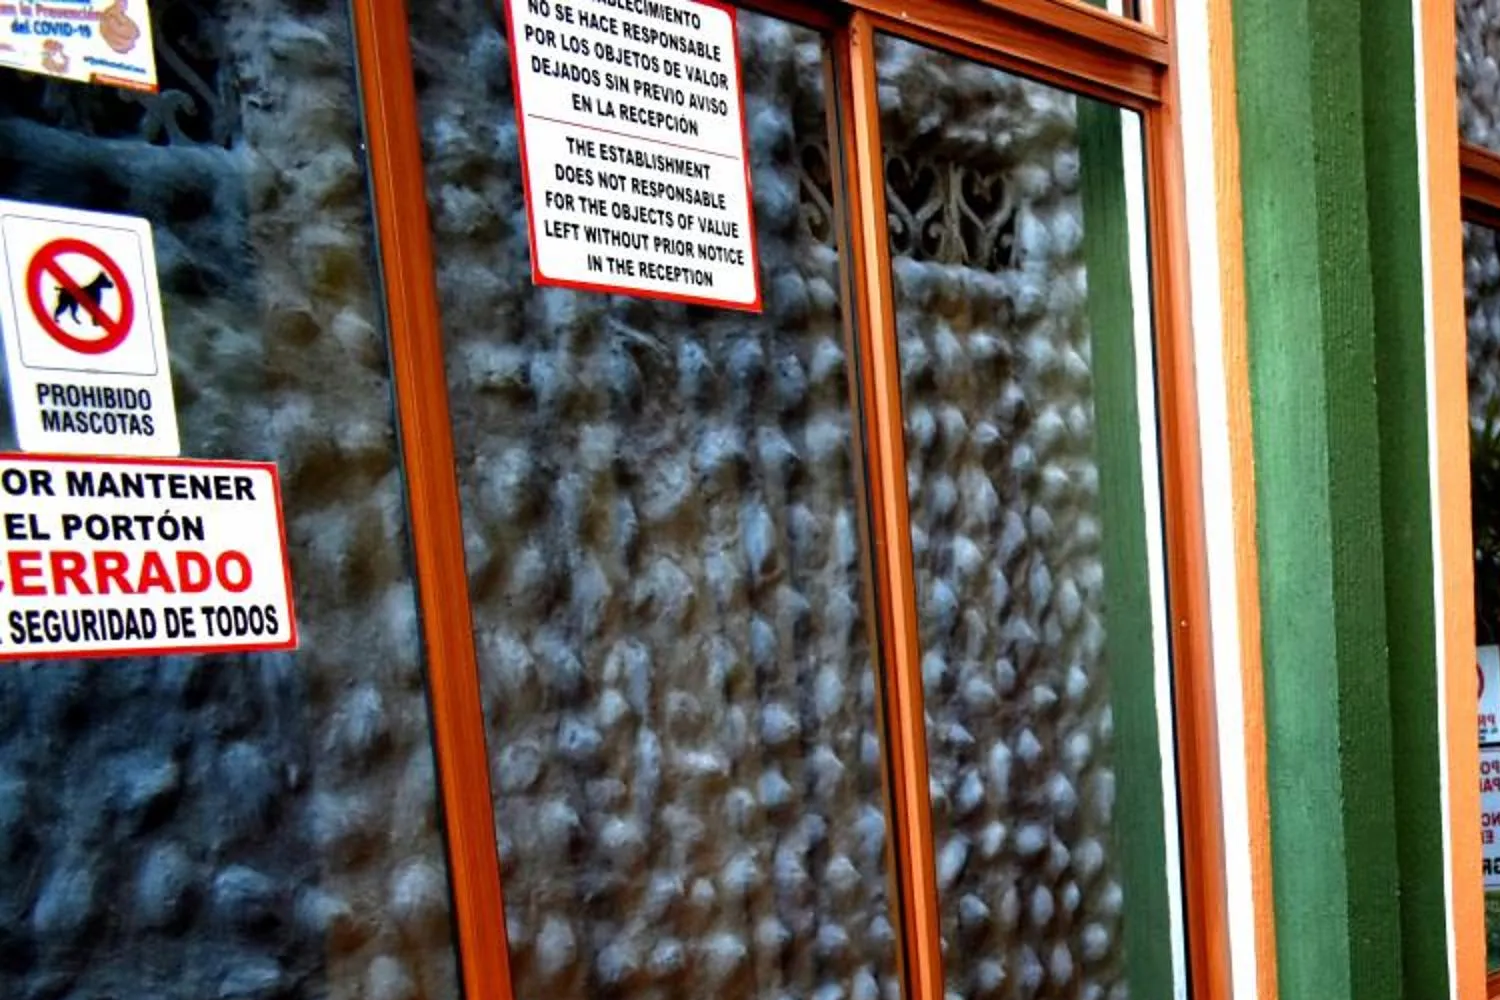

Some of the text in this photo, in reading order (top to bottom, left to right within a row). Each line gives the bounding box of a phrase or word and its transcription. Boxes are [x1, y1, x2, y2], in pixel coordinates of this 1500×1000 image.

[33, 20, 92, 39] COVID-19
[528, 0, 721, 62] NO SE HACE RESPONSABLE
[524, 24, 729, 90] POR LOS OBJETOS DE VALOR
[531, 55, 728, 117] DEJADOS SIN PREVIO AVISO
[572, 93, 699, 136] EN LA RECEPCIÓN
[566, 136, 711, 180] THE ESTABLISHMENT
[555, 163, 726, 210] DOES NOT RESPONSABLE
[545, 191, 739, 239] FOR THE OBJECTS OF VALUE
[544, 219, 744, 266] LEFT WITHOUT PRIOR NOTICE
[587, 254, 713, 287] IN THE RECEPTION
[36, 382, 153, 411] PROHIBIDO
[41, 410, 155, 436] MASCOTAS
[1, 469, 256, 501] OR MANTENER
[4, 509, 205, 541] EL PORTÓN
[0, 550, 253, 596] ERRADO
[9, 604, 279, 645] SEGURIDAD DE TODOS
